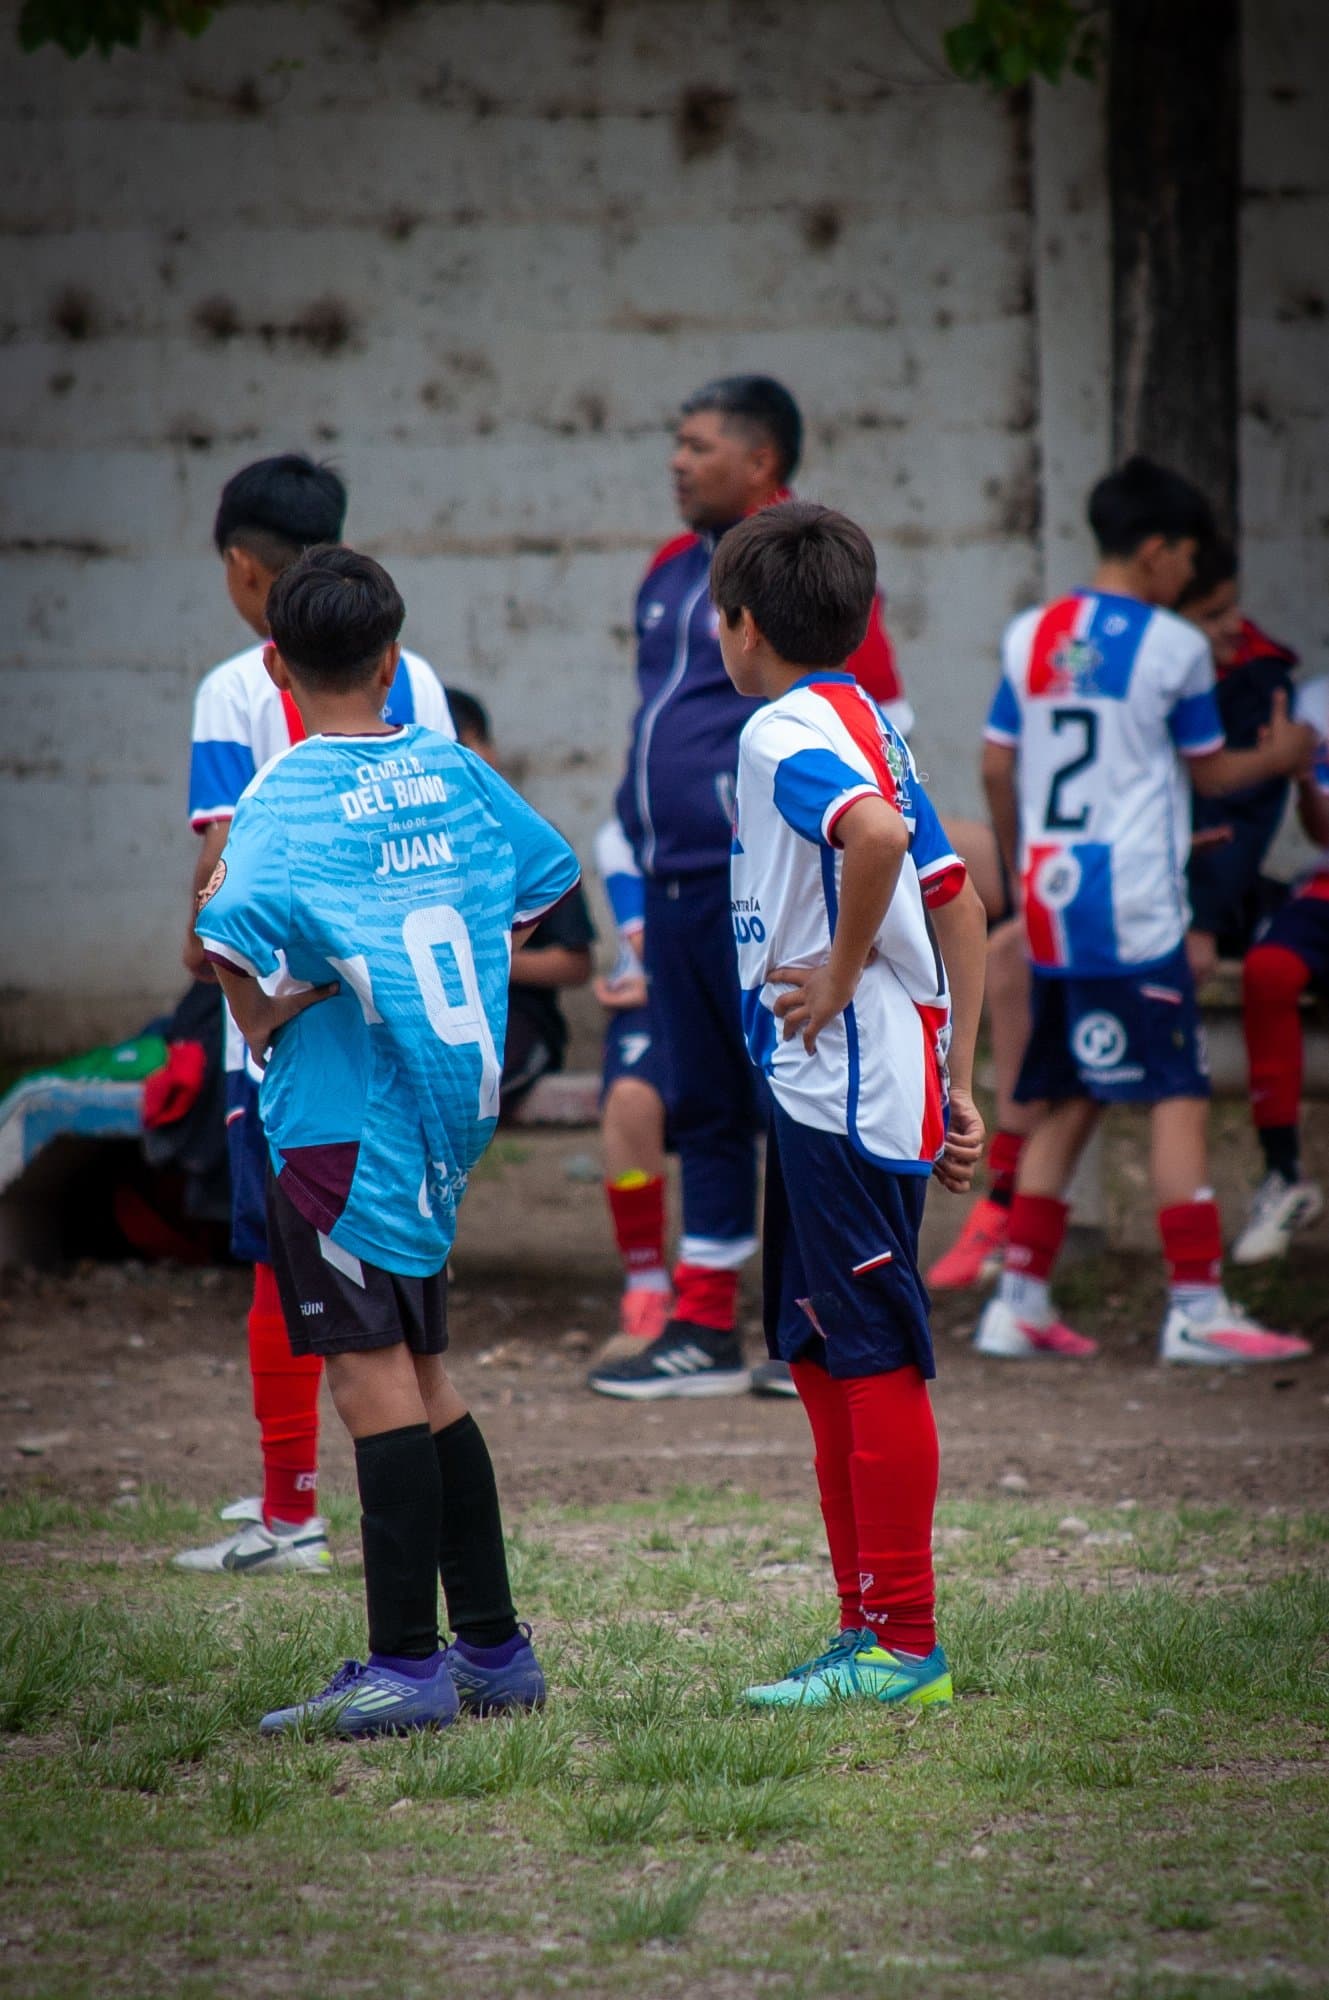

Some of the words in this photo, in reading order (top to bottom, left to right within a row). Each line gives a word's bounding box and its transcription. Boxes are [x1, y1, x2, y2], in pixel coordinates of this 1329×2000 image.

[356, 759, 399, 785] CLUB
[1044, 709, 1098, 831] 2
[339, 784, 393, 820] DEL
[392, 775, 447, 809] BONO
[375, 832, 453, 876] JUAN
[402, 904, 501, 1121] 9
